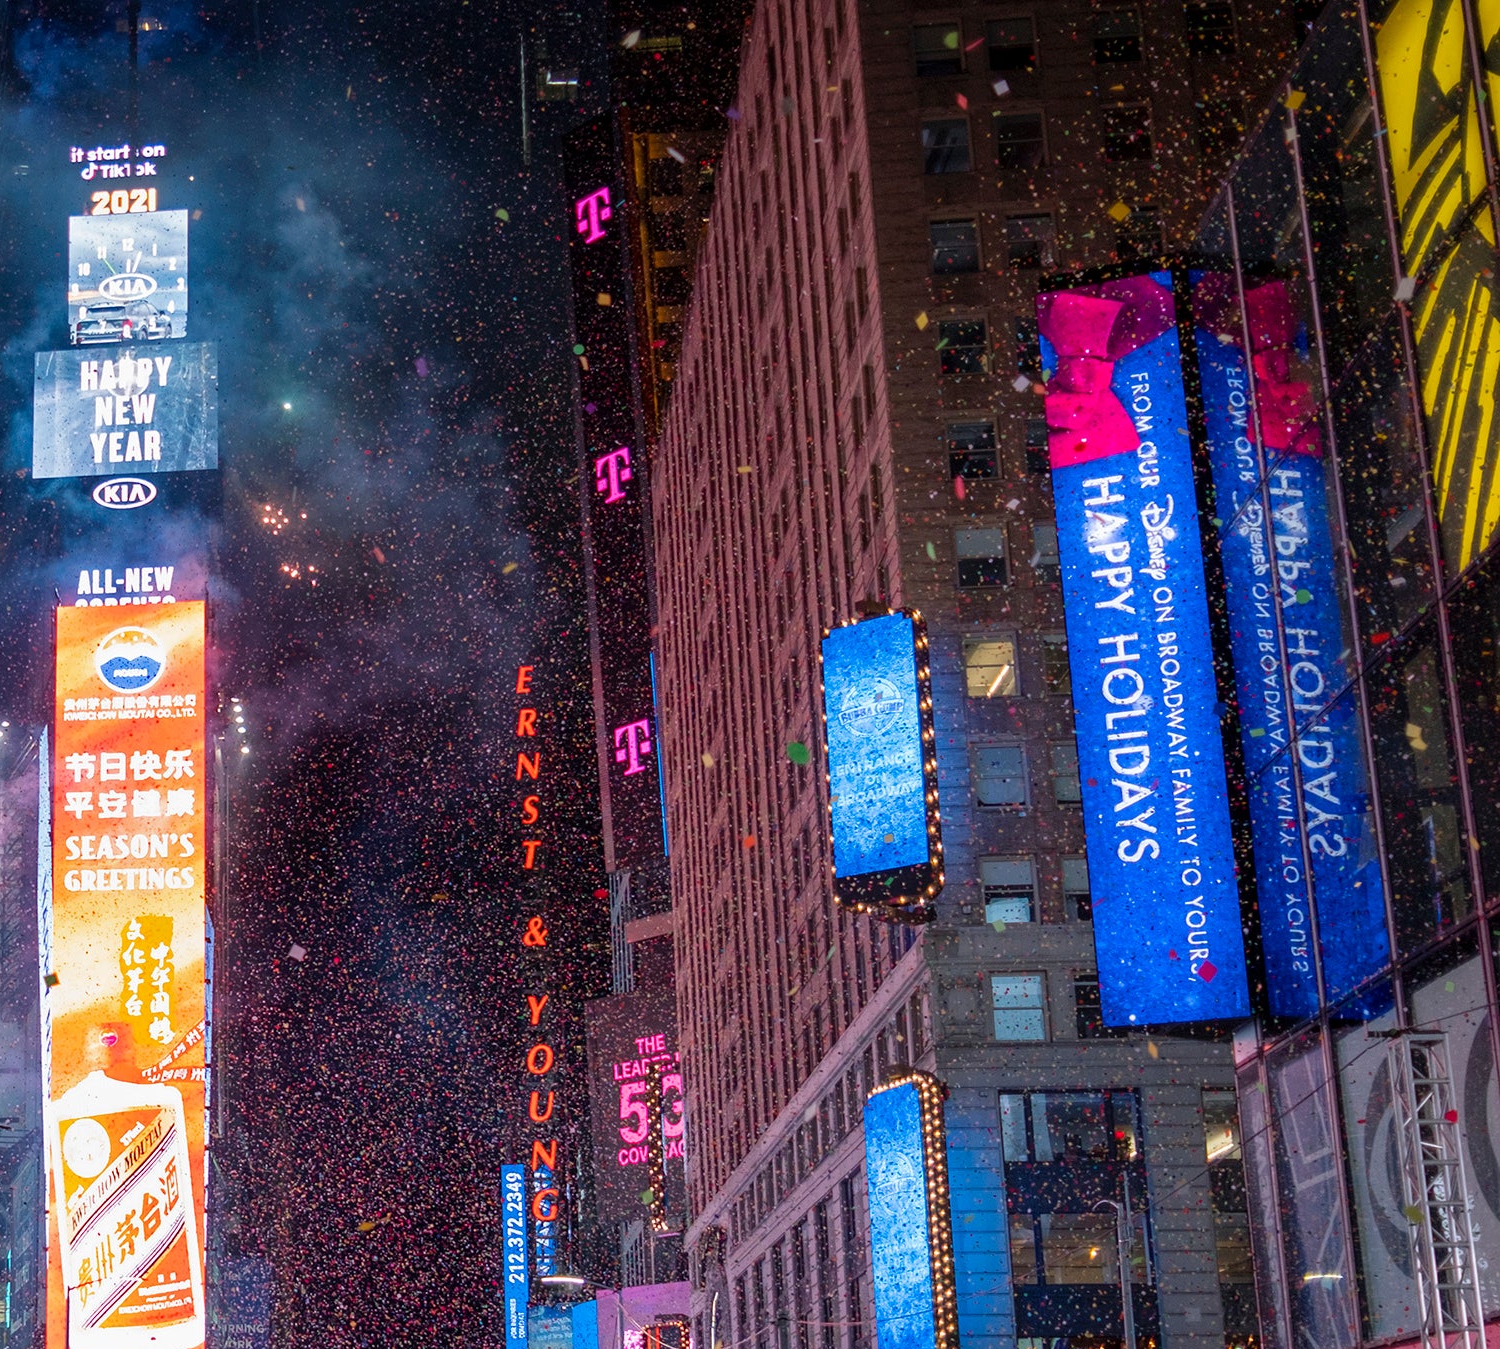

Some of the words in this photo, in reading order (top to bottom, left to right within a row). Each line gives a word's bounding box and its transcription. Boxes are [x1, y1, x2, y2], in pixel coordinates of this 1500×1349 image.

[71, 147, 84, 163] it
[142, 145, 166, 158] on
[92, 188, 157, 216] 2021
[80, 356, 173, 392] HAPPY
[95, 393, 156, 427] NEW
[1130, 371, 1154, 434] FROM
[90, 430, 162, 464] YEAR
[1136, 440, 1161, 490] OUR
[104, 484, 147, 503] KIA
[1081, 474, 1137, 615] HAPPY
[77, 566, 175, 595] ALL-NEW
[1152, 586, 1176, 624] ON
[1157, 631, 1190, 759] BROADWAY
[1097, 632, 1162, 864] HOLIDAYS
[64, 750, 196, 783] 节日快乐
[516, 665, 542, 870] ERNST
[63, 787, 196, 820] 平安健康
[1171, 767, 1200, 848] FAMILY
[65, 831, 196, 861] SEASON'S
[63, 866, 195, 892] GREETINGS
[1178, 856, 1203, 888] TO
[521, 916, 549, 948] &
[634, 1034, 668, 1055] THE
[525, 993, 560, 1224] YOUNG
[77, 1156, 181, 1309] 贵州茅台酒
[506, 1172, 525, 1285] 212.372.2349
